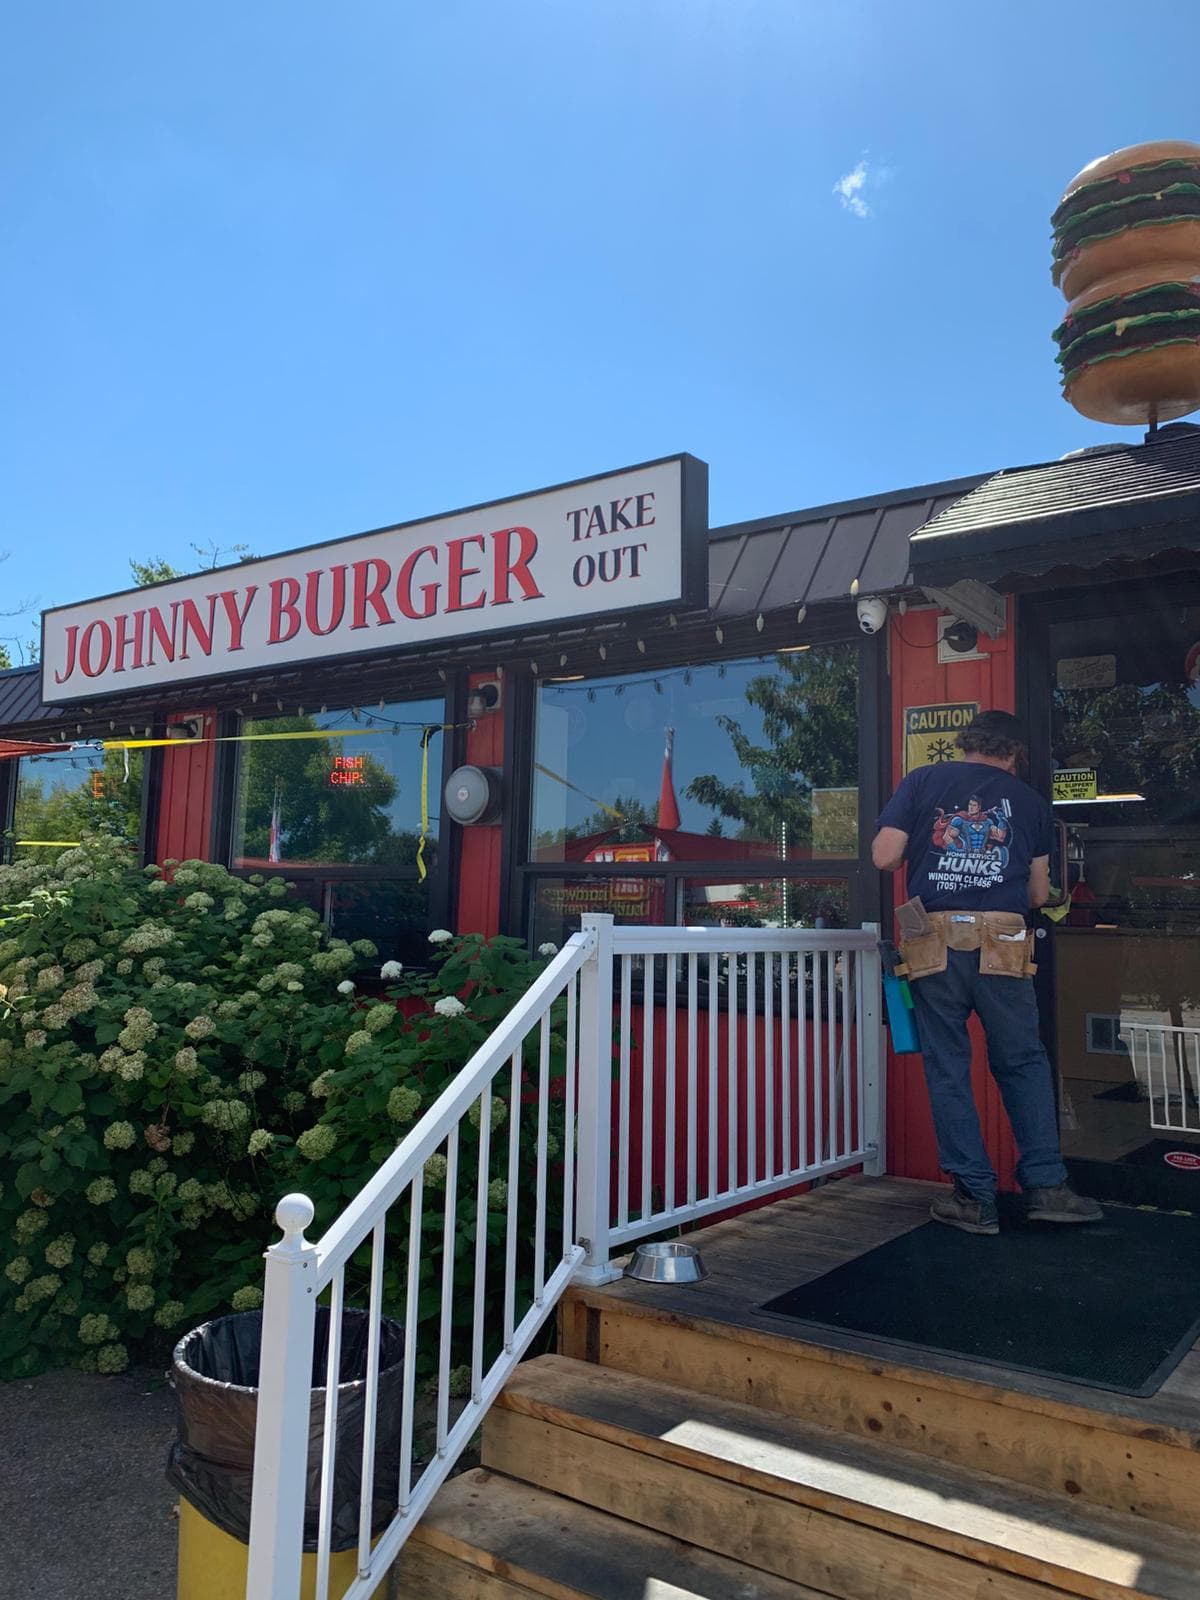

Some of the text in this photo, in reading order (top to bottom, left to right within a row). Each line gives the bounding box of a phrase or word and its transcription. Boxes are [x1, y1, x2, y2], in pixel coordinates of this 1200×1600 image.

[566, 492, 656, 542] TAKE
[572, 543, 648, 588] OUT
[54, 526, 545, 684] JOHNNY BURGER
[910, 708, 973, 730] CAUTION
[335, 756, 363, 769] FISH
[1055, 773, 1093, 781] CAUTION
[938, 858, 1002, 875] HUNKS
[928, 872, 962, 882] WINDOW
[937, 882, 957, 892] (705)
